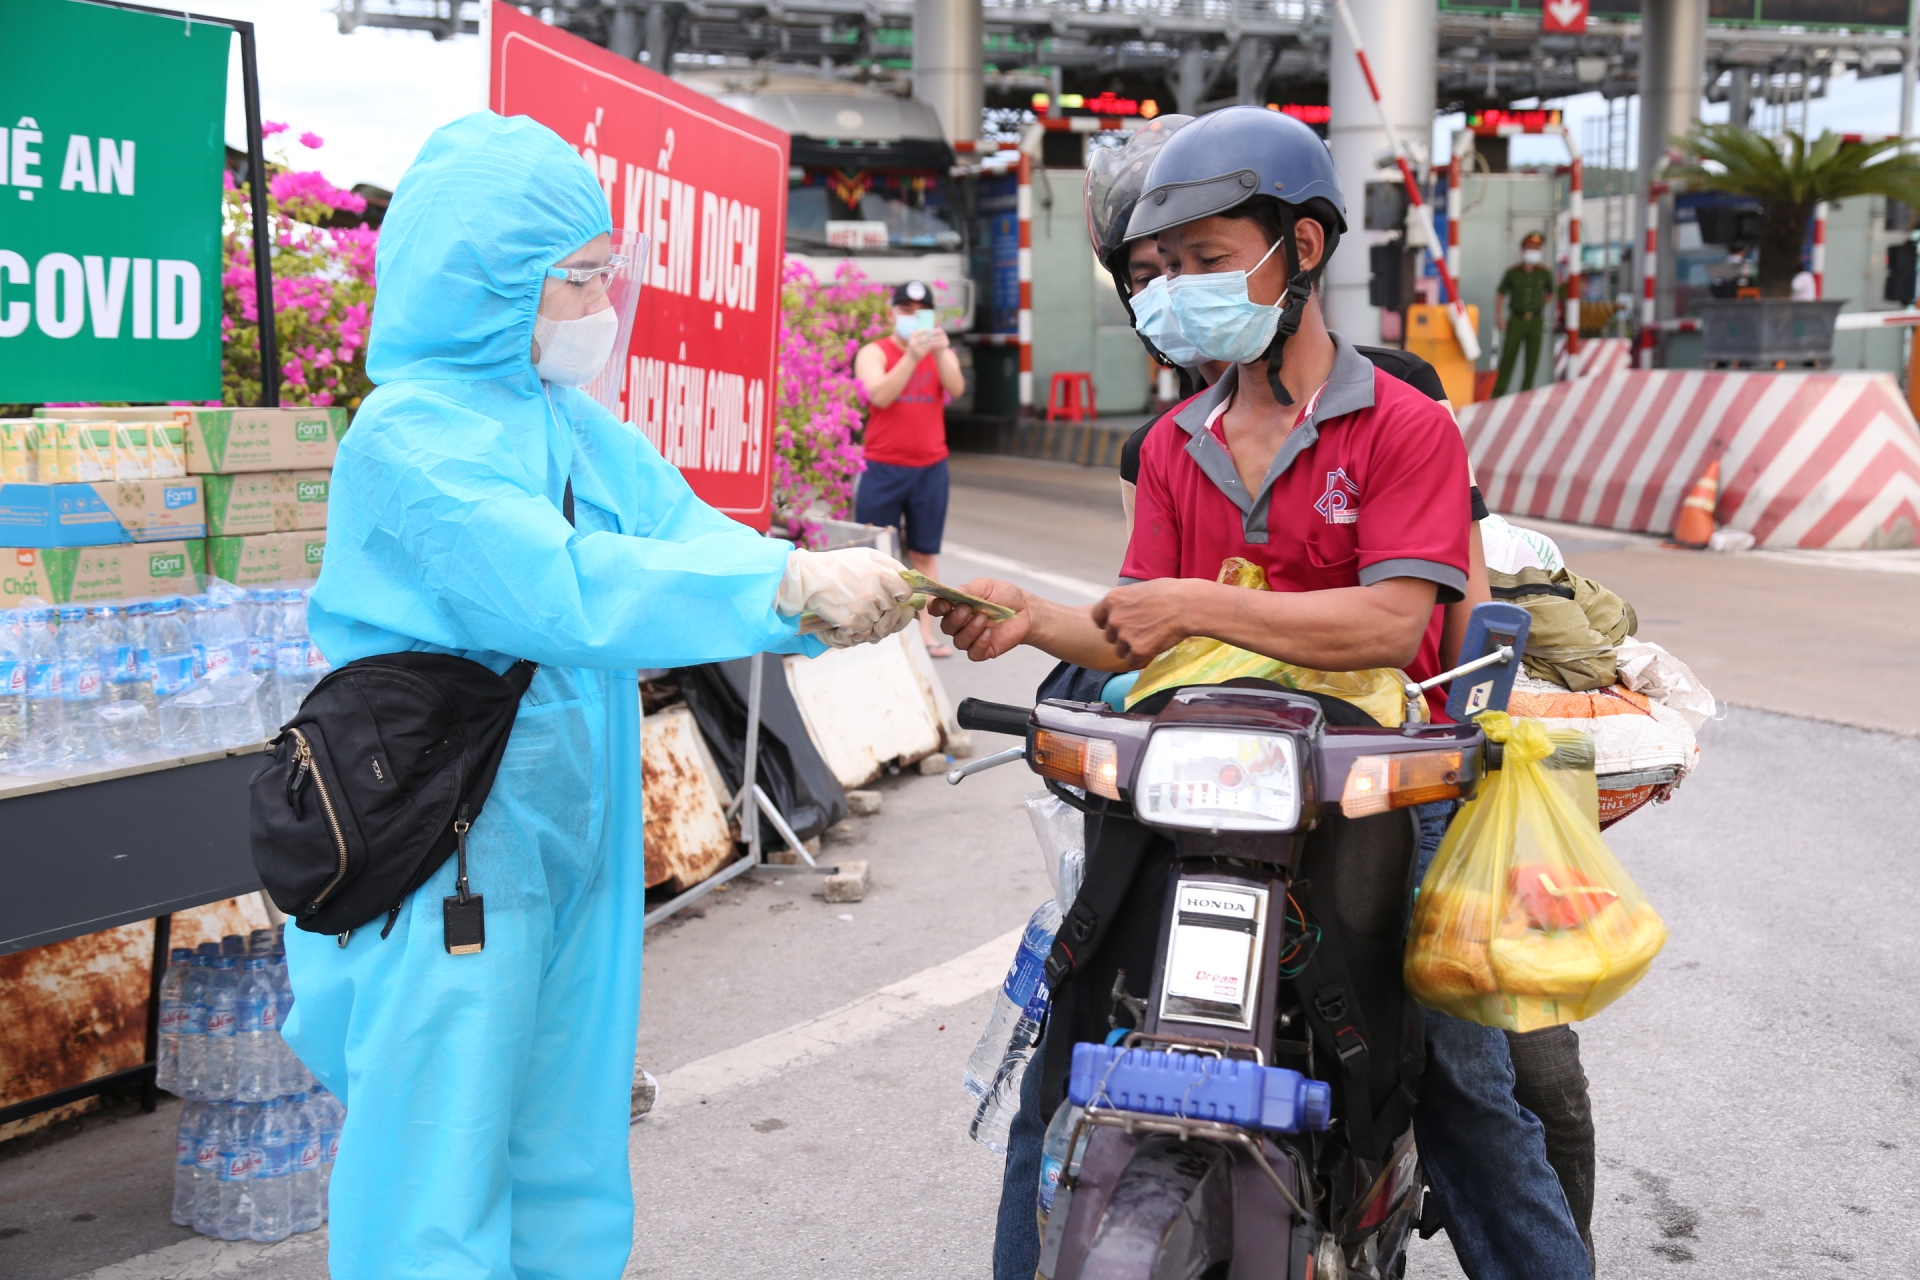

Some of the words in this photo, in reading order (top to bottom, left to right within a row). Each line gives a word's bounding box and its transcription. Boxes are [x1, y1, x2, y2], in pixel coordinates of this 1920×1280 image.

[60, 134, 136, 196] AN
[698, 190, 761, 330] DỊCH
[704, 368, 765, 476] COVID-19
[1187, 898, 1247, 912] HONDA
[1195, 970, 1238, 985] Dream
